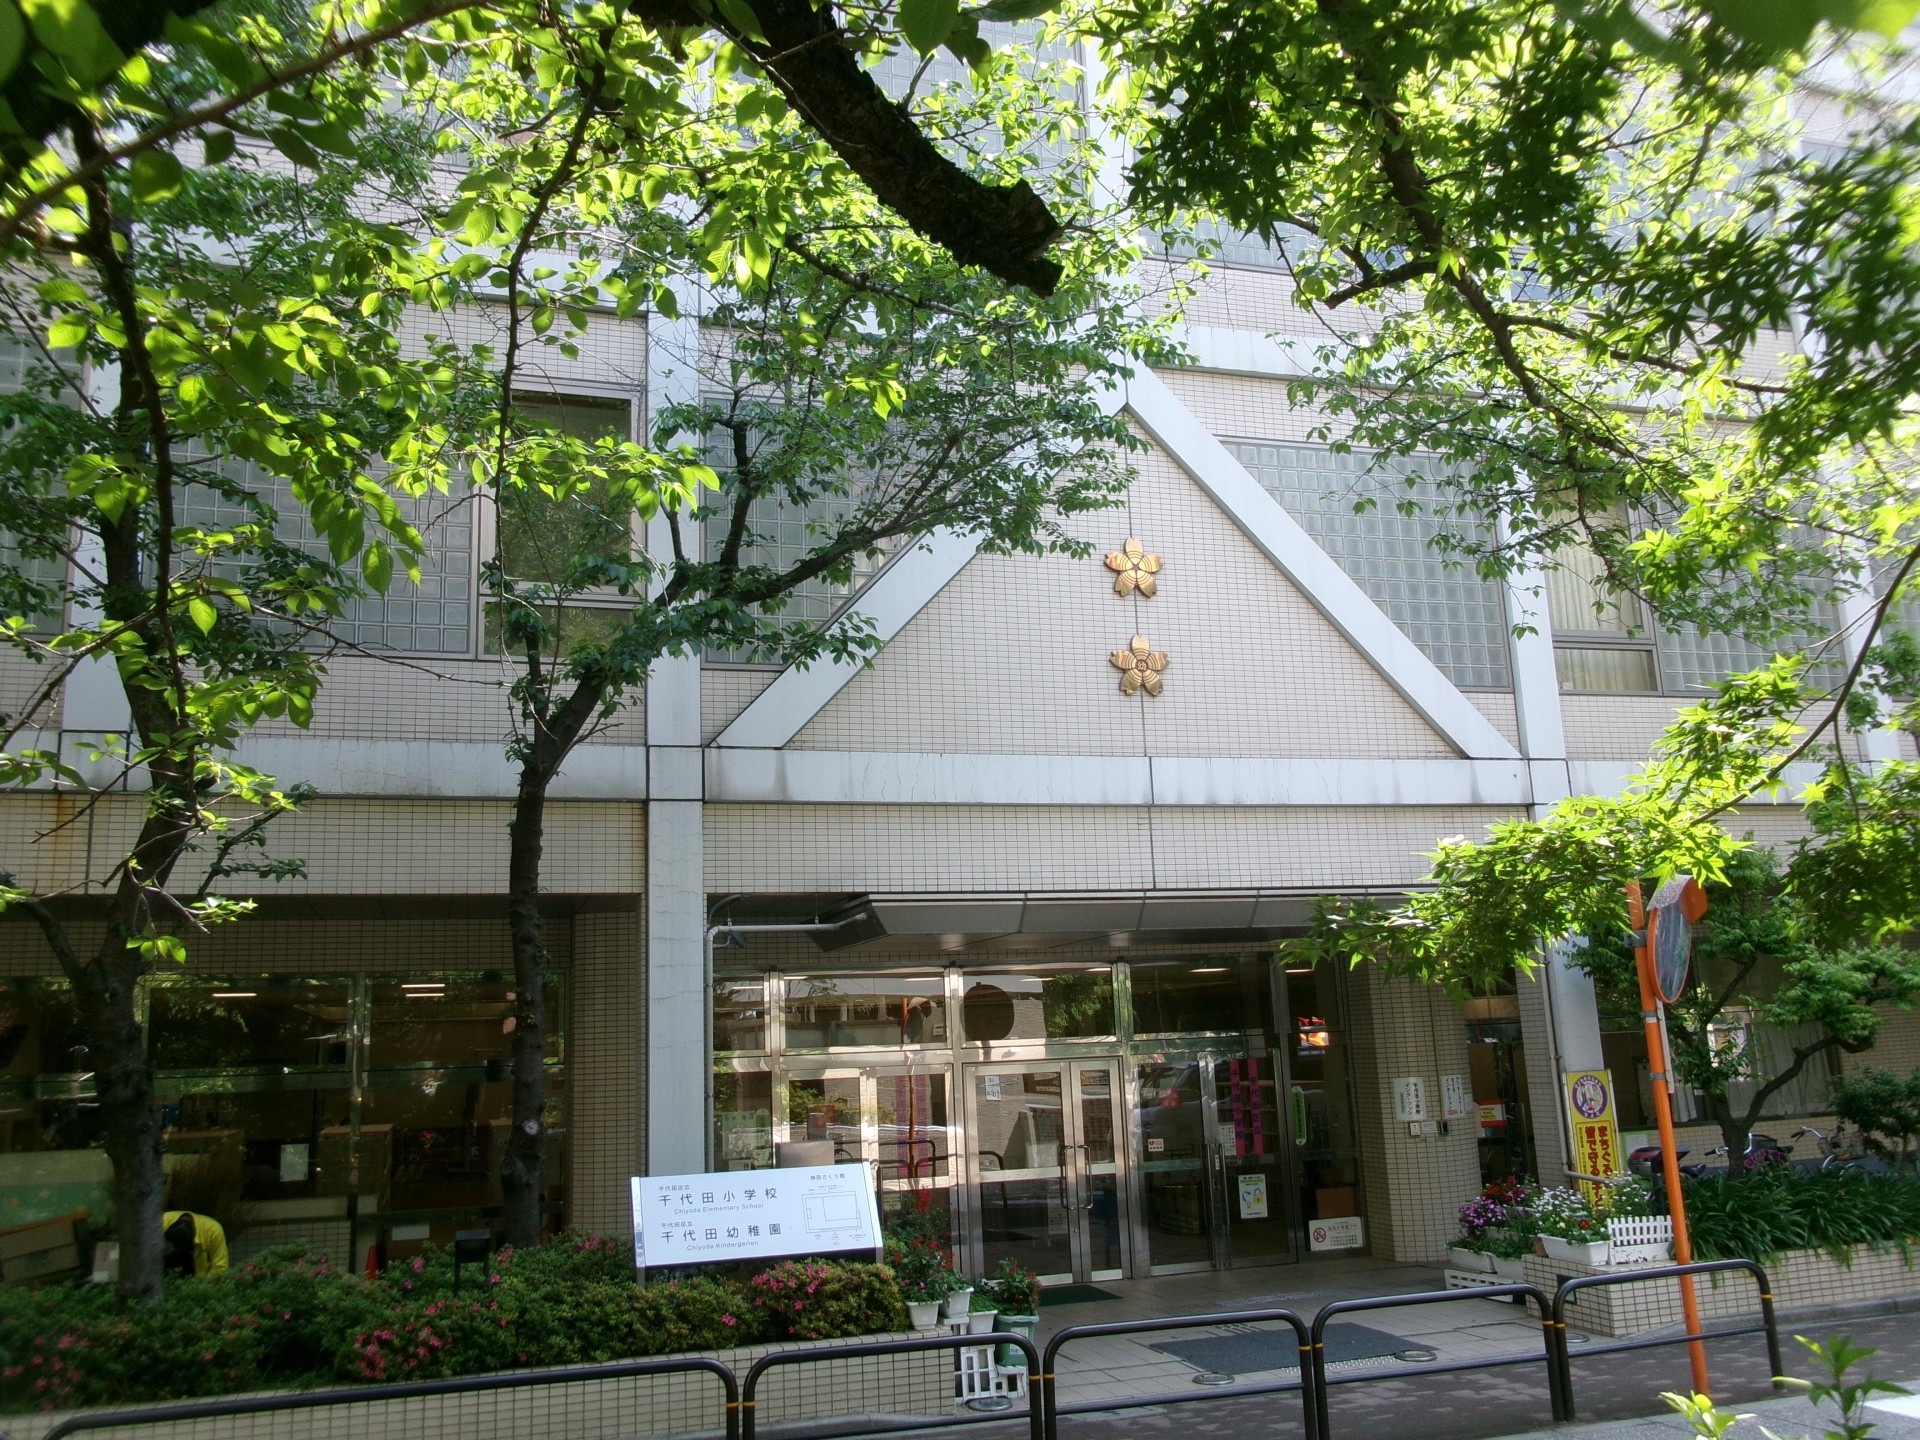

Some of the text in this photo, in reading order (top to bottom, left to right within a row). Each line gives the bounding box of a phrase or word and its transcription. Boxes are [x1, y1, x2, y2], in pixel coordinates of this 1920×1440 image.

[1231, 1070, 1244, 1139] 千代田小学校
[1250, 1077, 1261, 1134] 千代田区立
[658, 1184, 691, 1192] 千代田区立
[658, 1187, 778, 1207] 千代田小学校
[673, 1207, 701, 1215] Chiyoda
[702, 1204, 740, 1213] Elementary
[661, 1222, 782, 1244] 千代田幼稚園
[686, 1240, 759, 1251] Chiyoda Kindergarten
